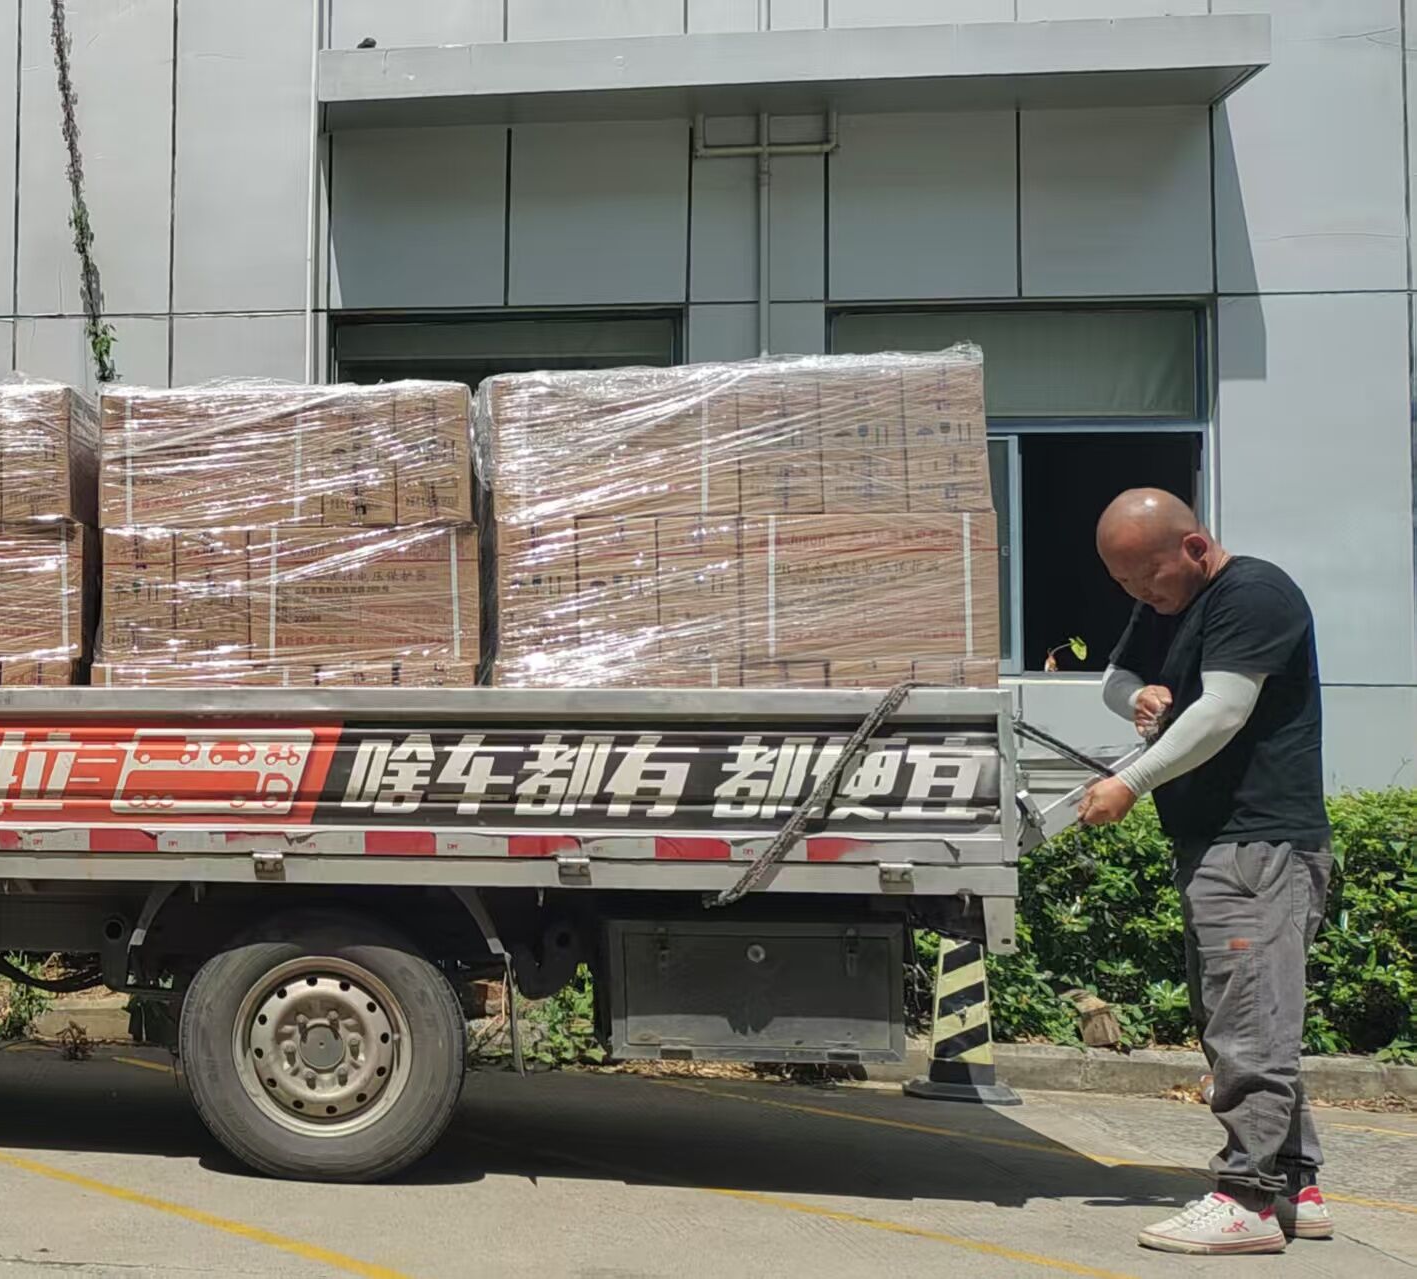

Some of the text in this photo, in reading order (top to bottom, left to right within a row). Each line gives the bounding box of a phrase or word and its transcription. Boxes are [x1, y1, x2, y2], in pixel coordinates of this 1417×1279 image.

[341, 734, 996, 819] 啥车都有 都便宜
